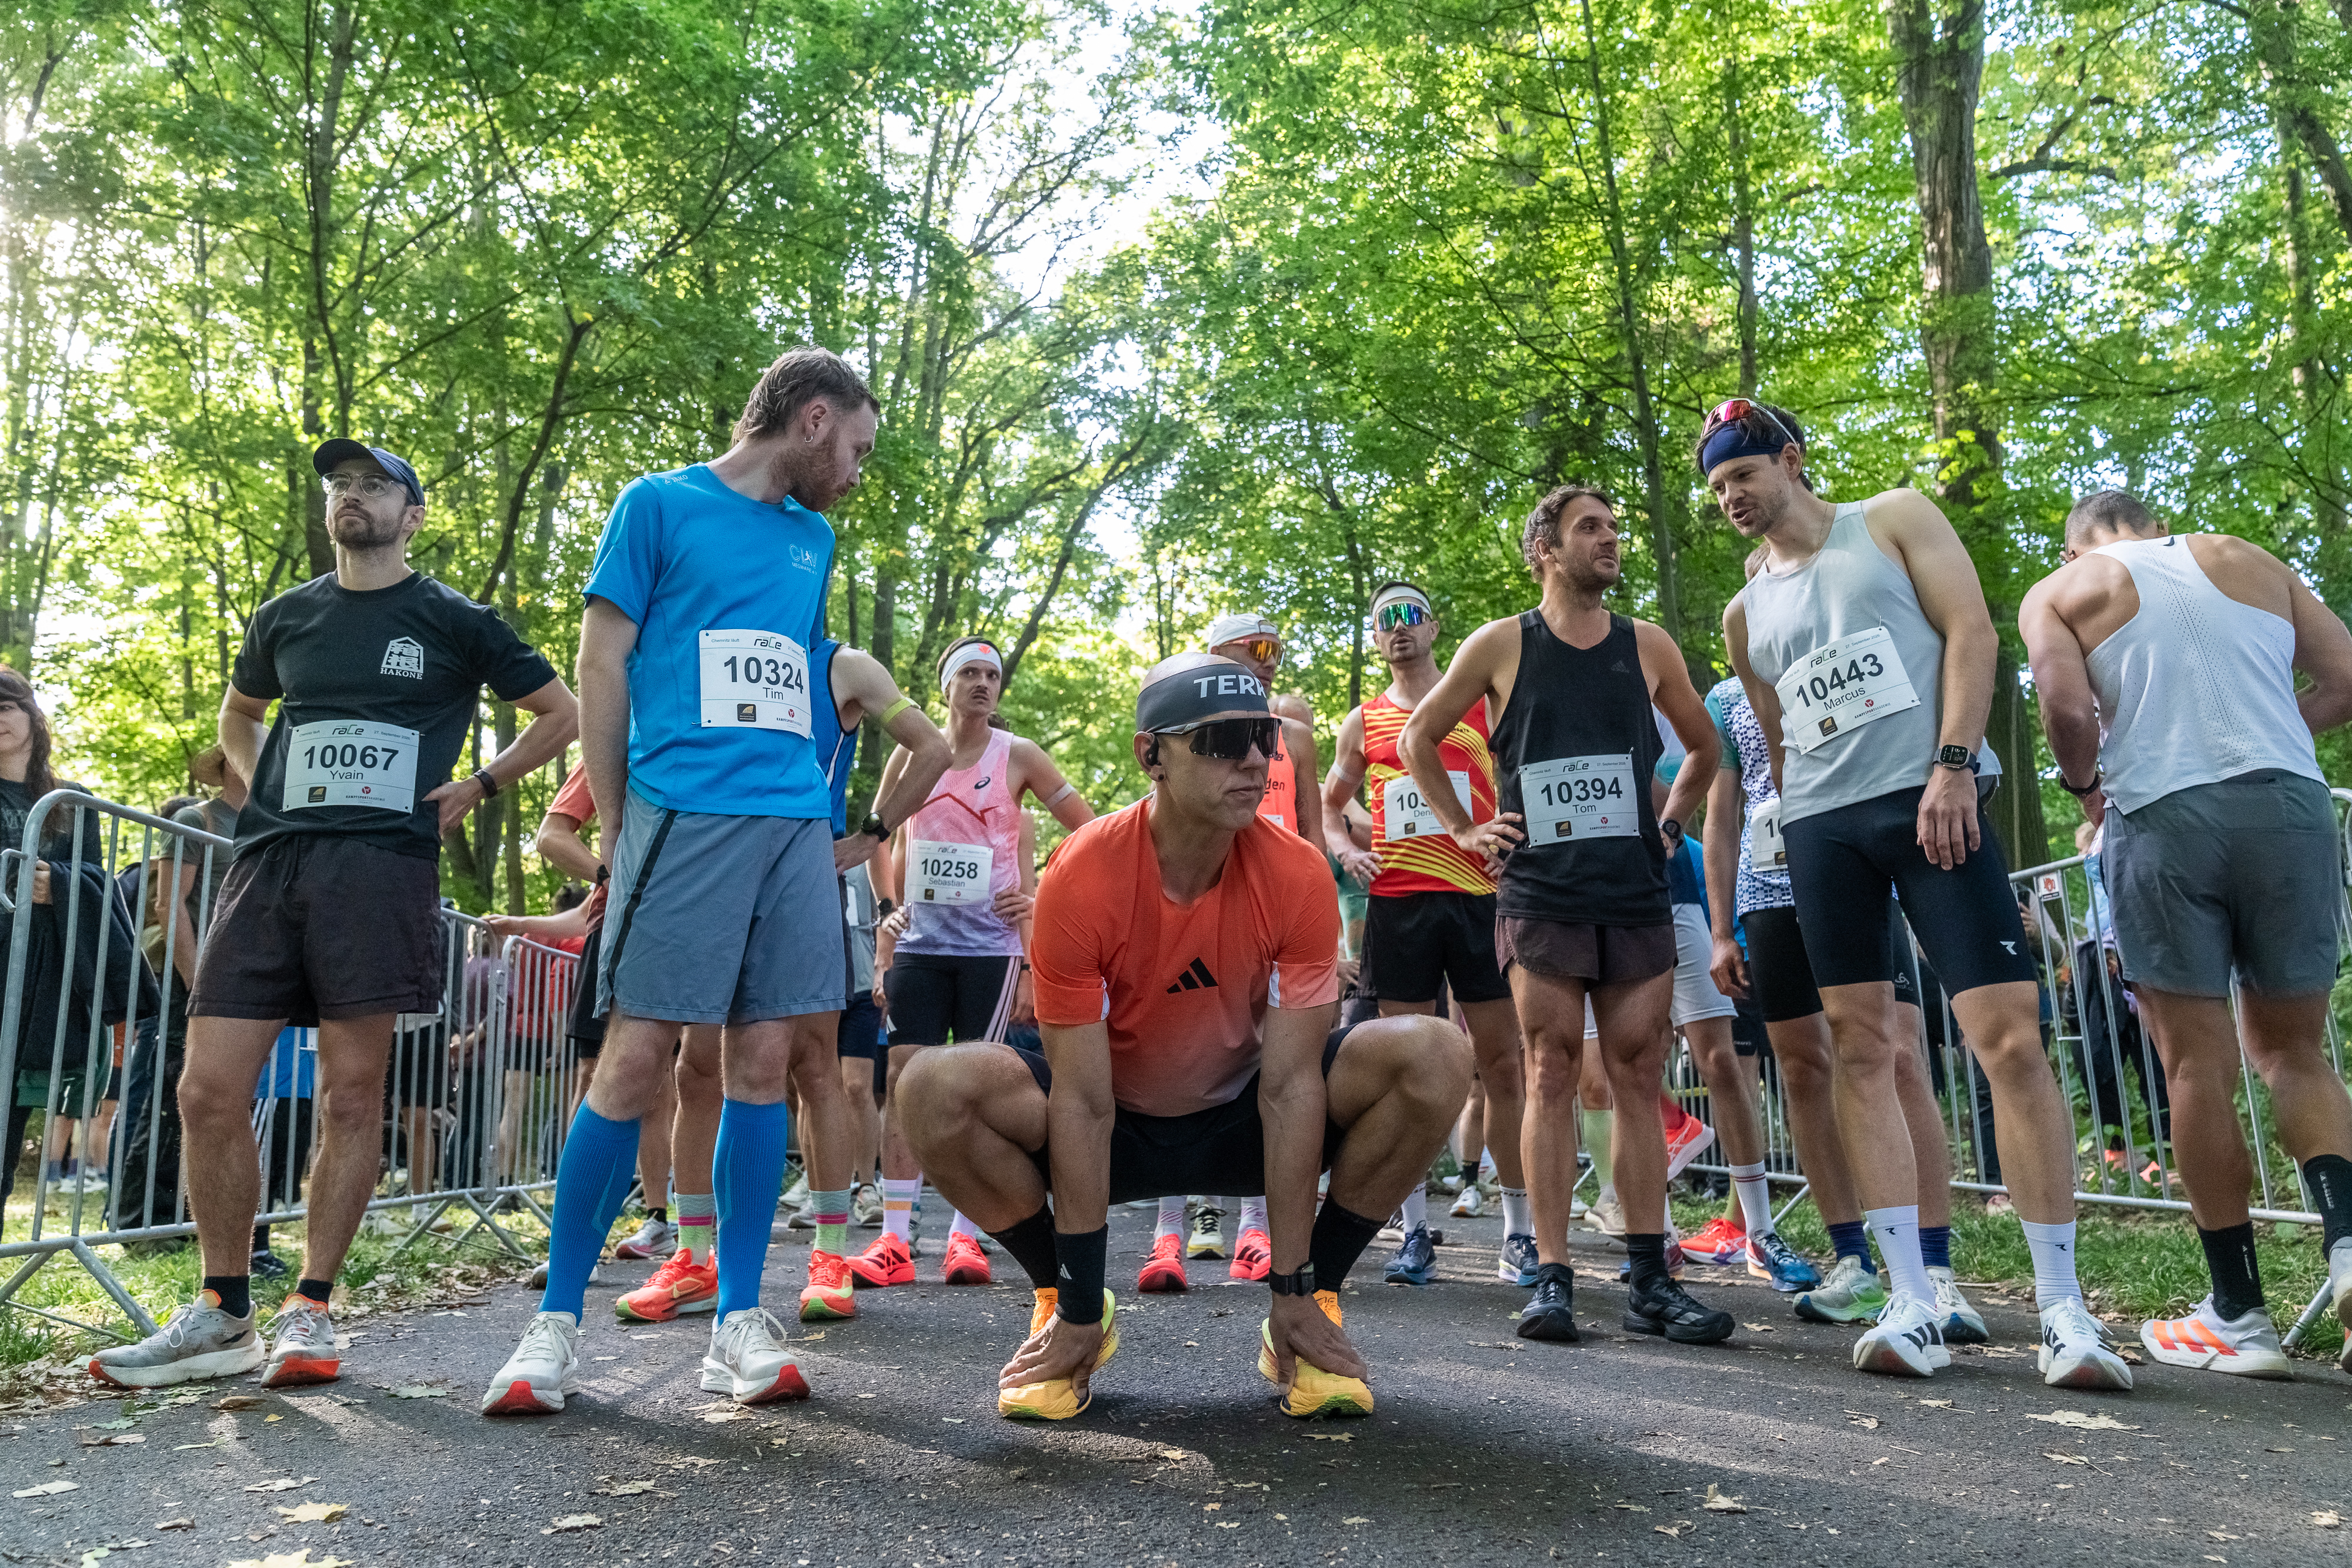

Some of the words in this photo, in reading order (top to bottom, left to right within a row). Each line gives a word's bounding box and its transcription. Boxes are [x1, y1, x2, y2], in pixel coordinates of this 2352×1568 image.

[1852, 637, 1870, 646] September
[380, 667, 423, 680] HAKONE
[724, 656, 804, 694] 10324
[1796, 653, 1884, 708] 10443
[762, 687, 784, 700] Tim
[1823, 687, 1866, 711] Marcus
[1854, 702, 1891, 719] KAMPFSPORTAKADEMIE
[304, 744, 399, 771] 10067
[329, 770, 364, 780] Yvain
[1541, 777, 1623, 806] 10394
[1572, 804, 1596, 814] Tom
[921, 858, 978, 880] 10258
[928, 877, 965, 887] Sebastian
